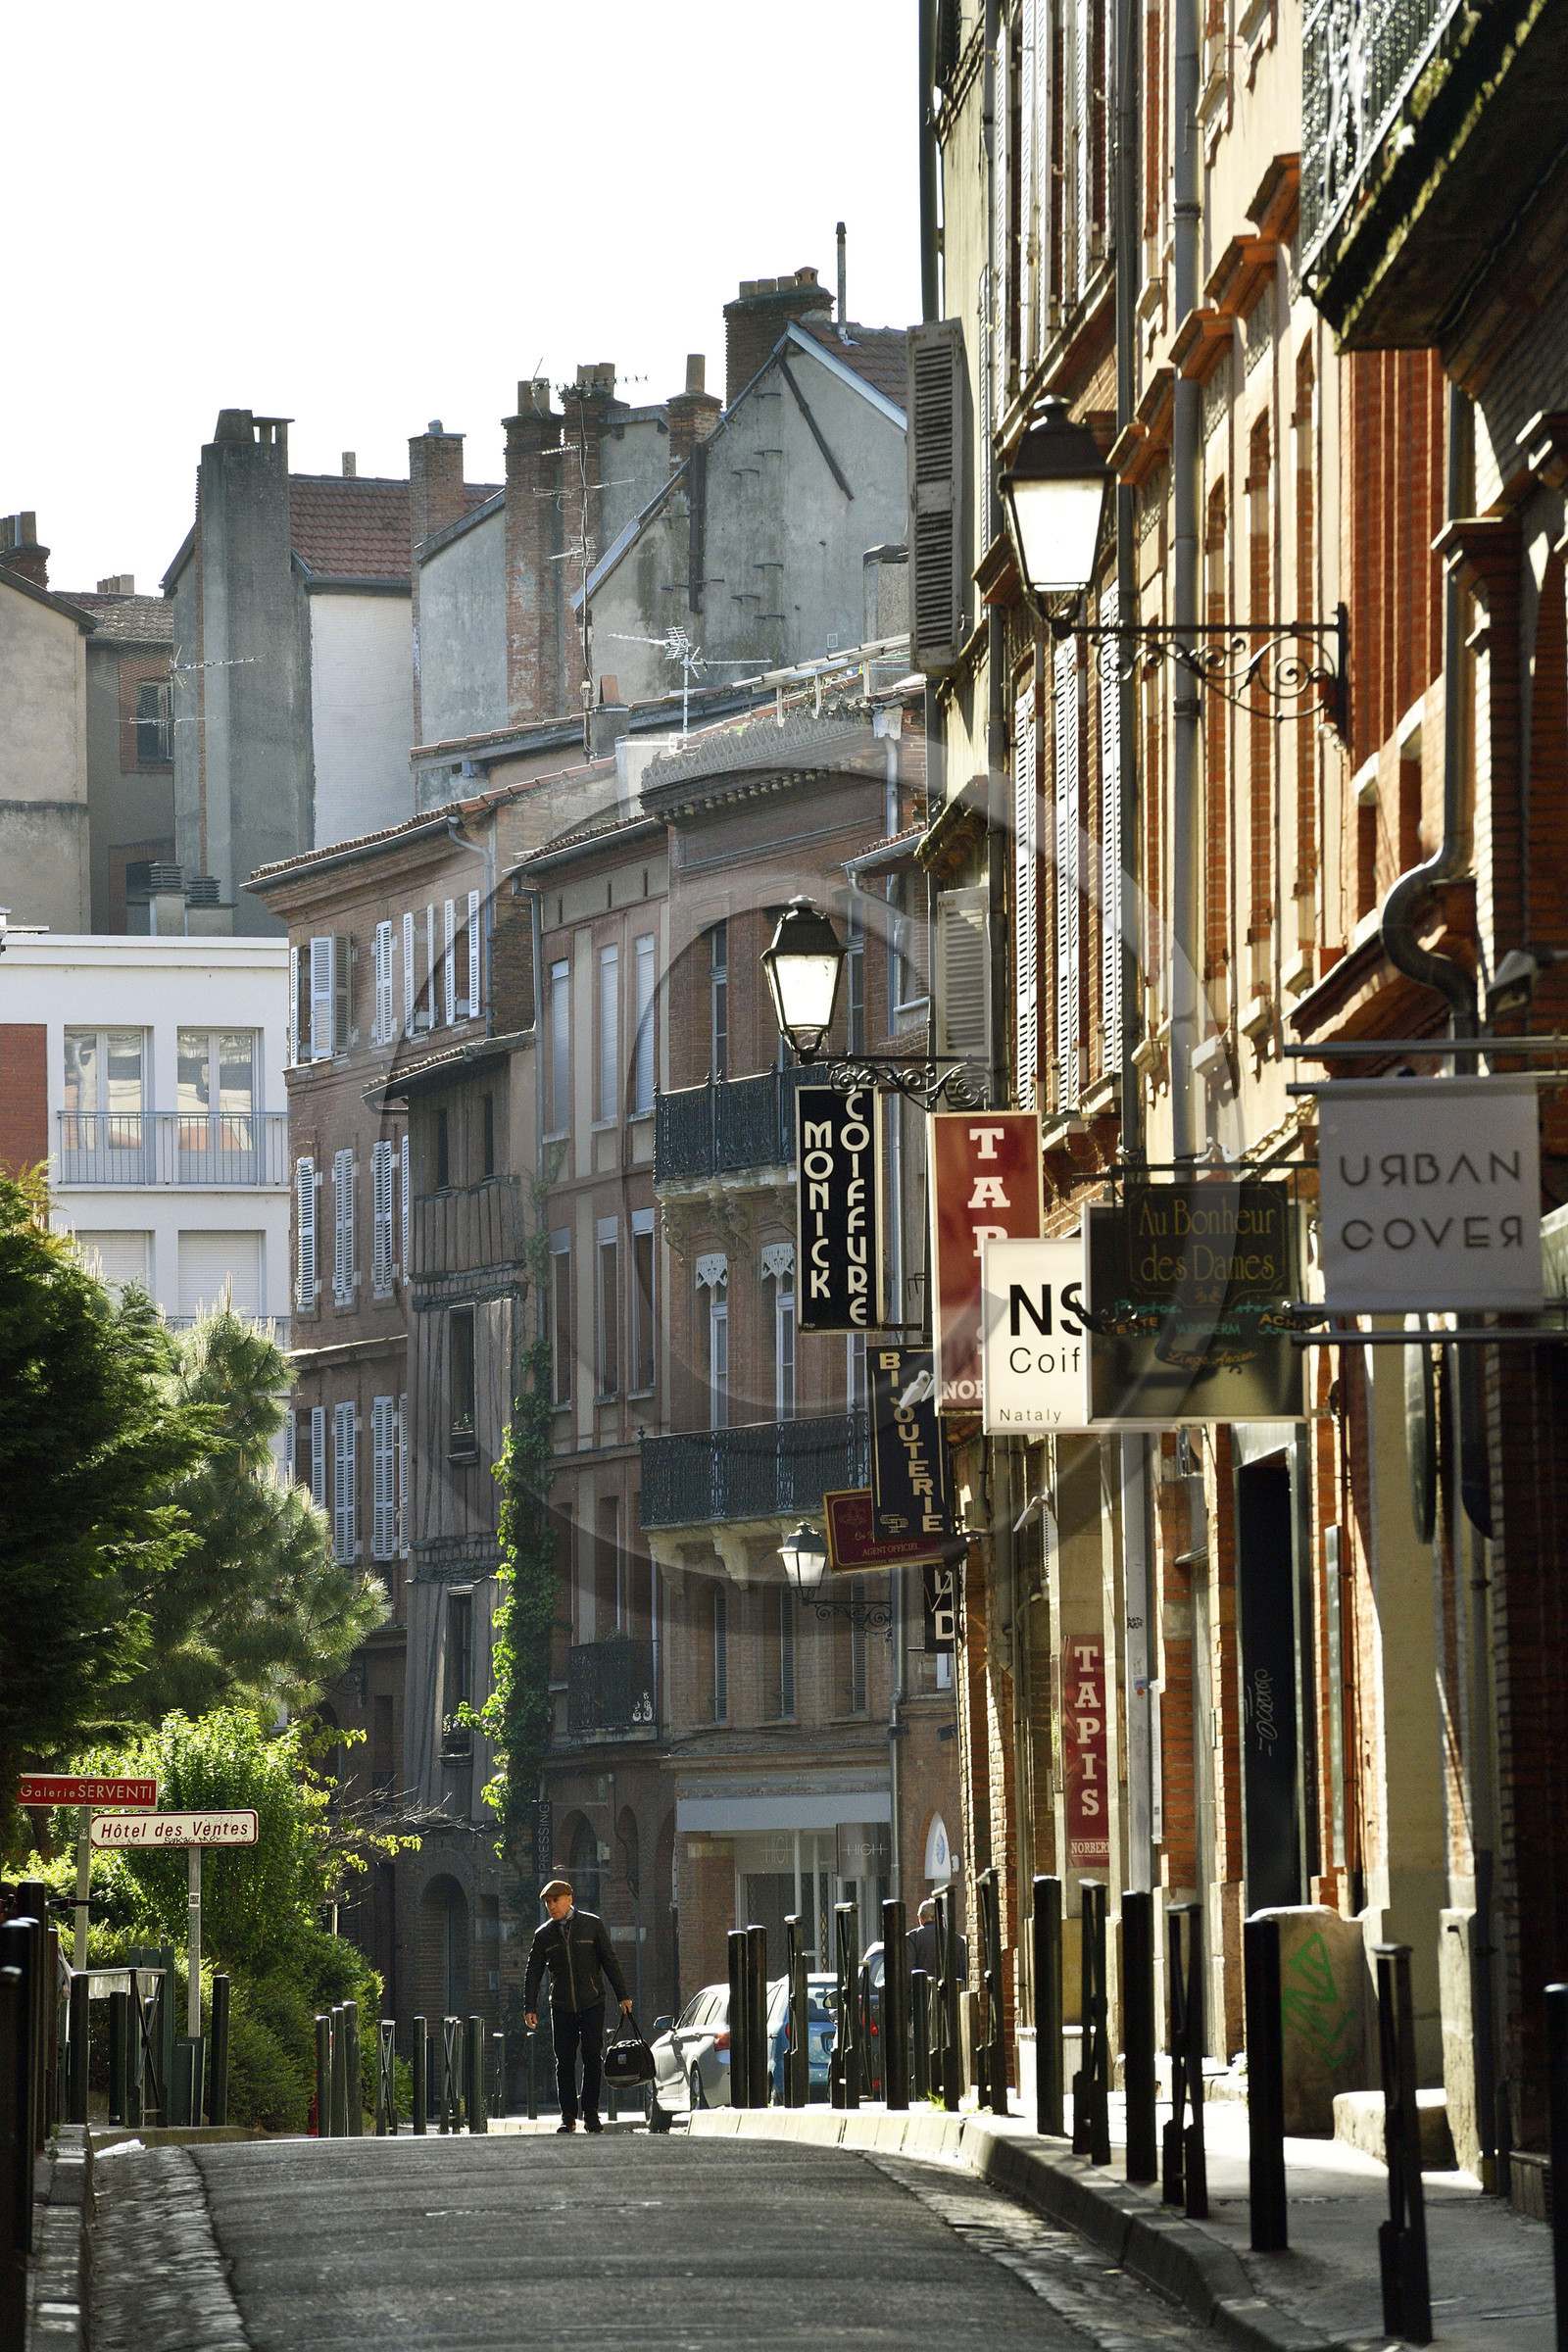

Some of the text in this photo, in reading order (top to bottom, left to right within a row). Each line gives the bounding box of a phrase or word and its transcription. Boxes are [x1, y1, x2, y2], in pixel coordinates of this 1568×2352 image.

[804, 1120, 834, 1298] MONICK
[840, 1092, 871, 1326] COIFFURE
[1139, 1198, 1276, 1235] Au Bonheur
[1140, 1243, 1275, 1282] des Dames
[1000, 1408, 1061, 1424] Nataly
[862, 1543, 918, 1556] AGENT OFFICIEL
[1074, 1645, 1102, 1816] TAPIS
[20, 1785, 153, 1799] Galerie SERVENTI
[101, 1823, 147, 1838] Hôtel
[155, 1822, 183, 1838] des
[193, 1821, 249, 1837] Ventes
[538, 1804, 550, 1872] PRESSING
[841, 1842, 888, 1856] HIGH
